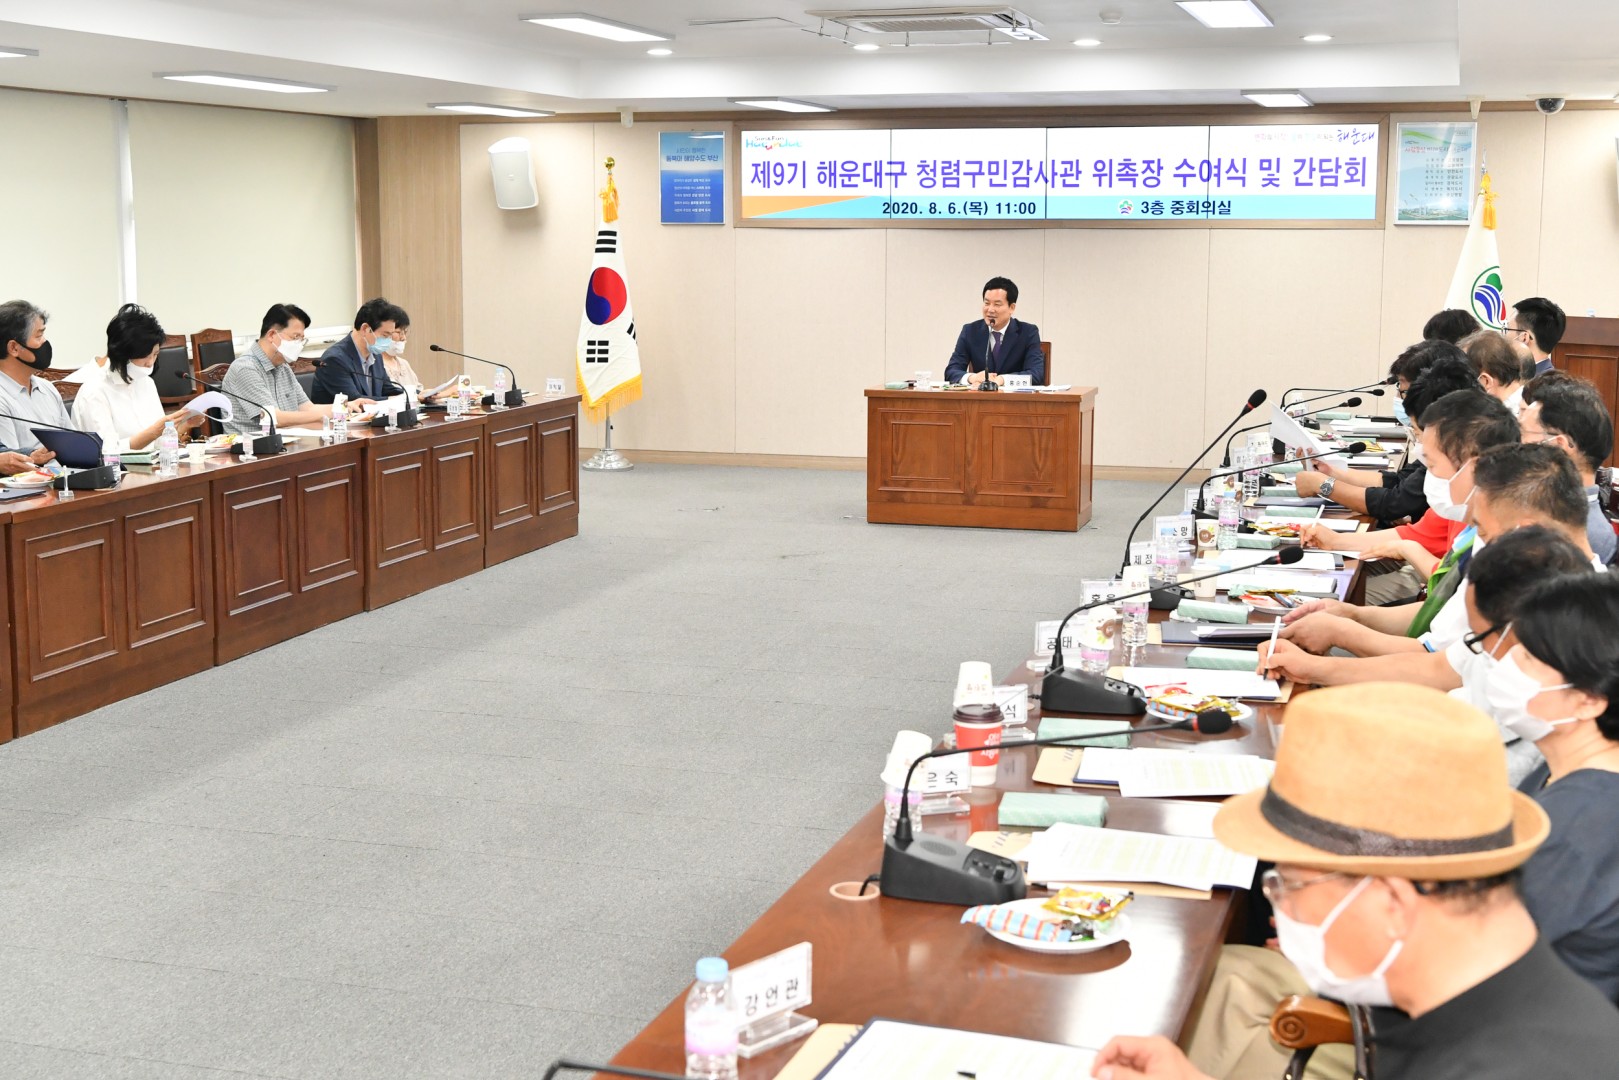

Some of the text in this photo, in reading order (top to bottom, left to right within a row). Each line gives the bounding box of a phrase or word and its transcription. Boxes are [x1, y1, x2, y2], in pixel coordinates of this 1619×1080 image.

[1337, 128, 1375, 145] 해운대
[751, 156, 1366, 188] 제9기 해운대구 청렴구민감사관 위촉장 수여식 및 간담회
[882, 202, 923, 215] 2020.
[929, 202, 942, 214] 8.
[995, 202, 1036, 215] 11:00
[1141, 200, 1231, 215] 3층 중회의실
